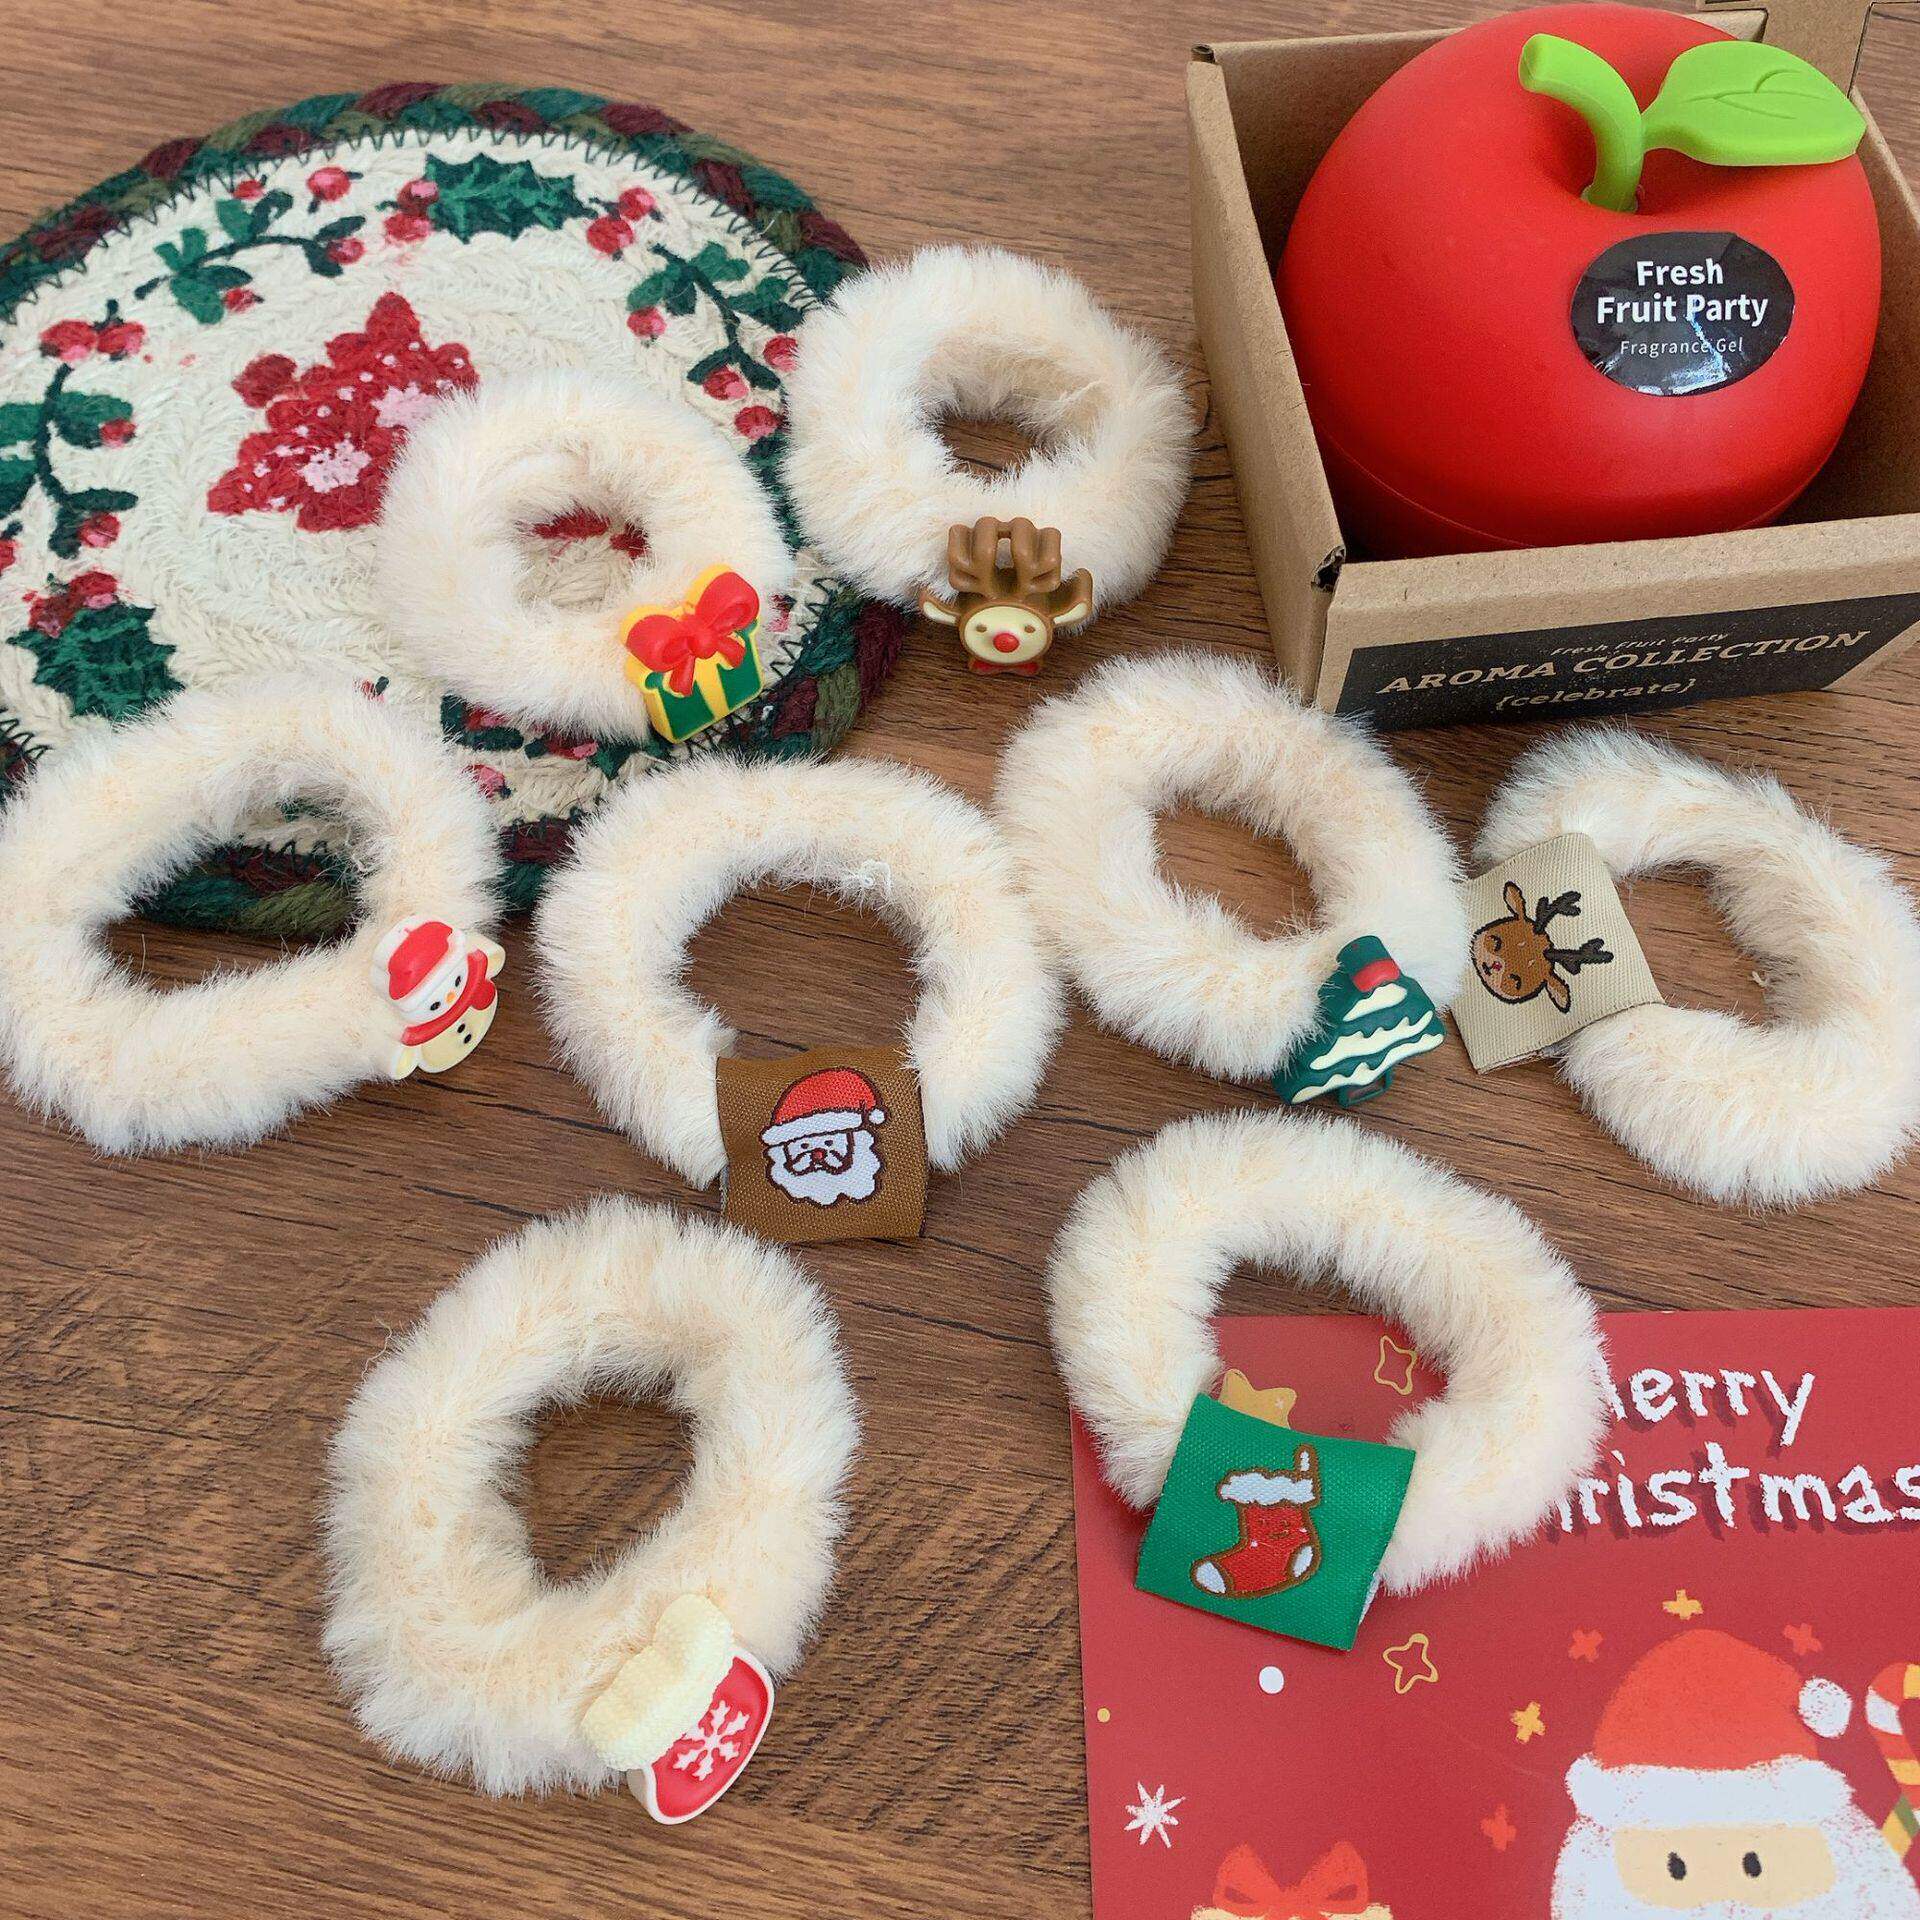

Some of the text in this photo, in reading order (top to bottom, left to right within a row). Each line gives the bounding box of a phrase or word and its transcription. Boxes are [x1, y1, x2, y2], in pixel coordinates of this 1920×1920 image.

[1636, 258, 1724, 287] Fresh
[1597, 292, 1769, 328] Fruit Party
[1620, 337, 1744, 358] Fragrance Gel
[1376, 631, 1871, 694] AROMA COLLECTION
[1496, 678, 1697, 712] {celebrate}
[1555, 1441, 1920, 1532] ristmas
